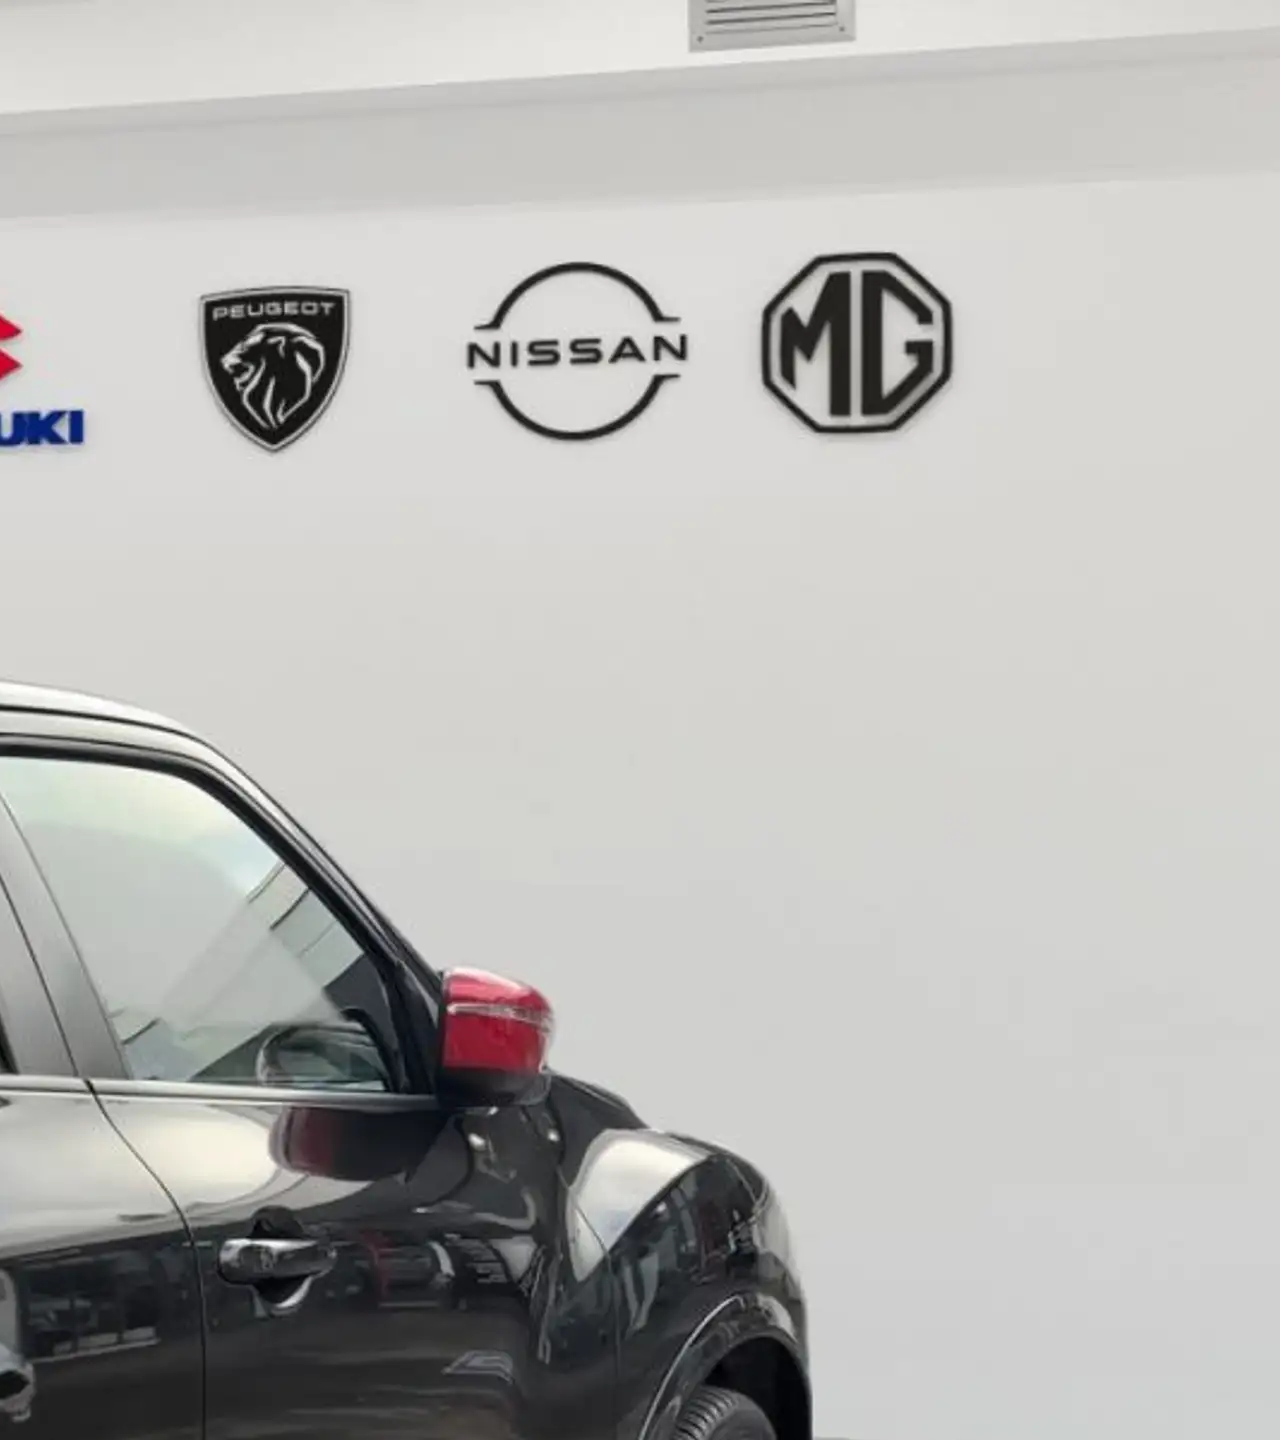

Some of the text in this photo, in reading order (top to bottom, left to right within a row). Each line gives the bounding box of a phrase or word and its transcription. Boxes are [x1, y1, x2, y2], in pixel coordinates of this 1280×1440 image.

[211, 300, 337, 321] PEUGEOT
[466, 333, 689, 369] NISSAN
[780, 269, 935, 418] MG
